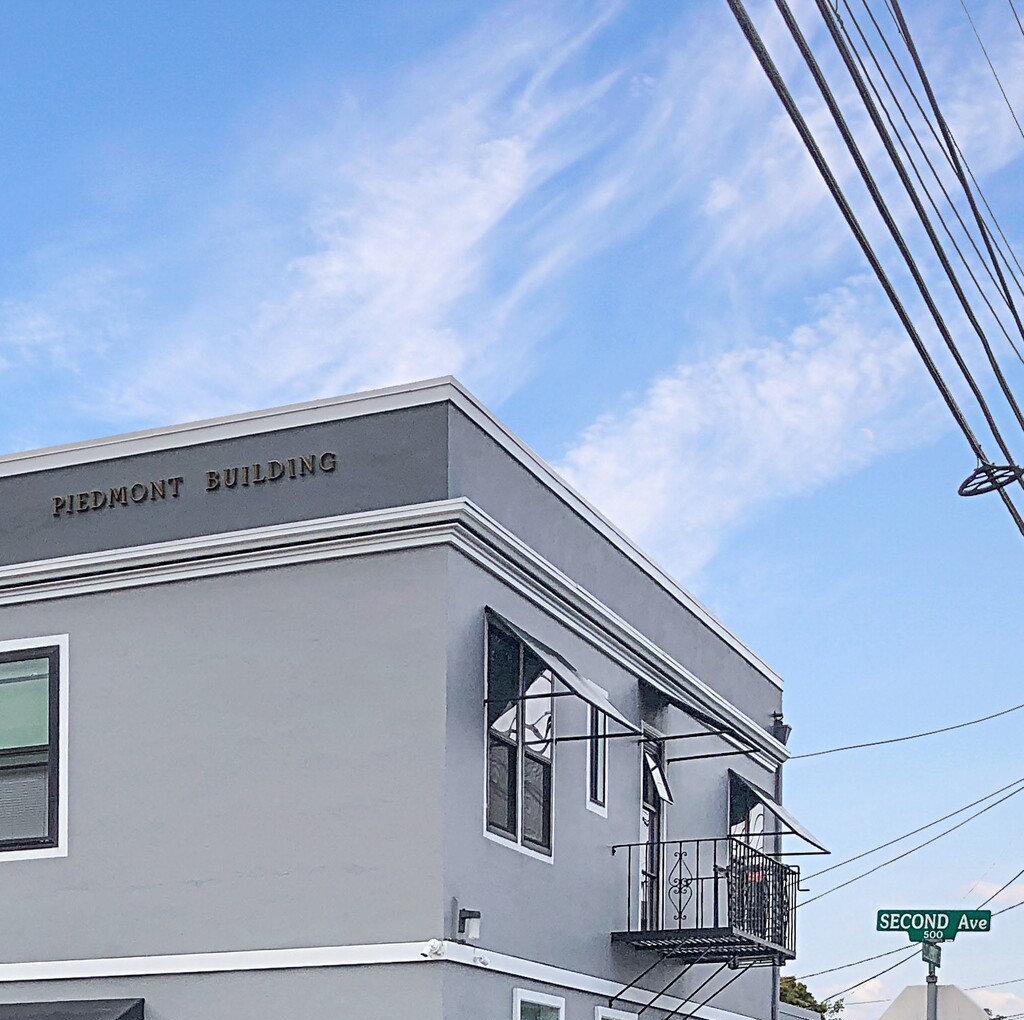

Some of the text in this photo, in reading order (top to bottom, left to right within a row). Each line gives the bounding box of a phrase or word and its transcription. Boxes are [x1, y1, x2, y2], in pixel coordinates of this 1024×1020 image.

[51, 452, 337, 516] PIEDMONT BUILDING
[879, 913, 987, 929] SECOND Ave
[923, 930, 943, 939] 500
